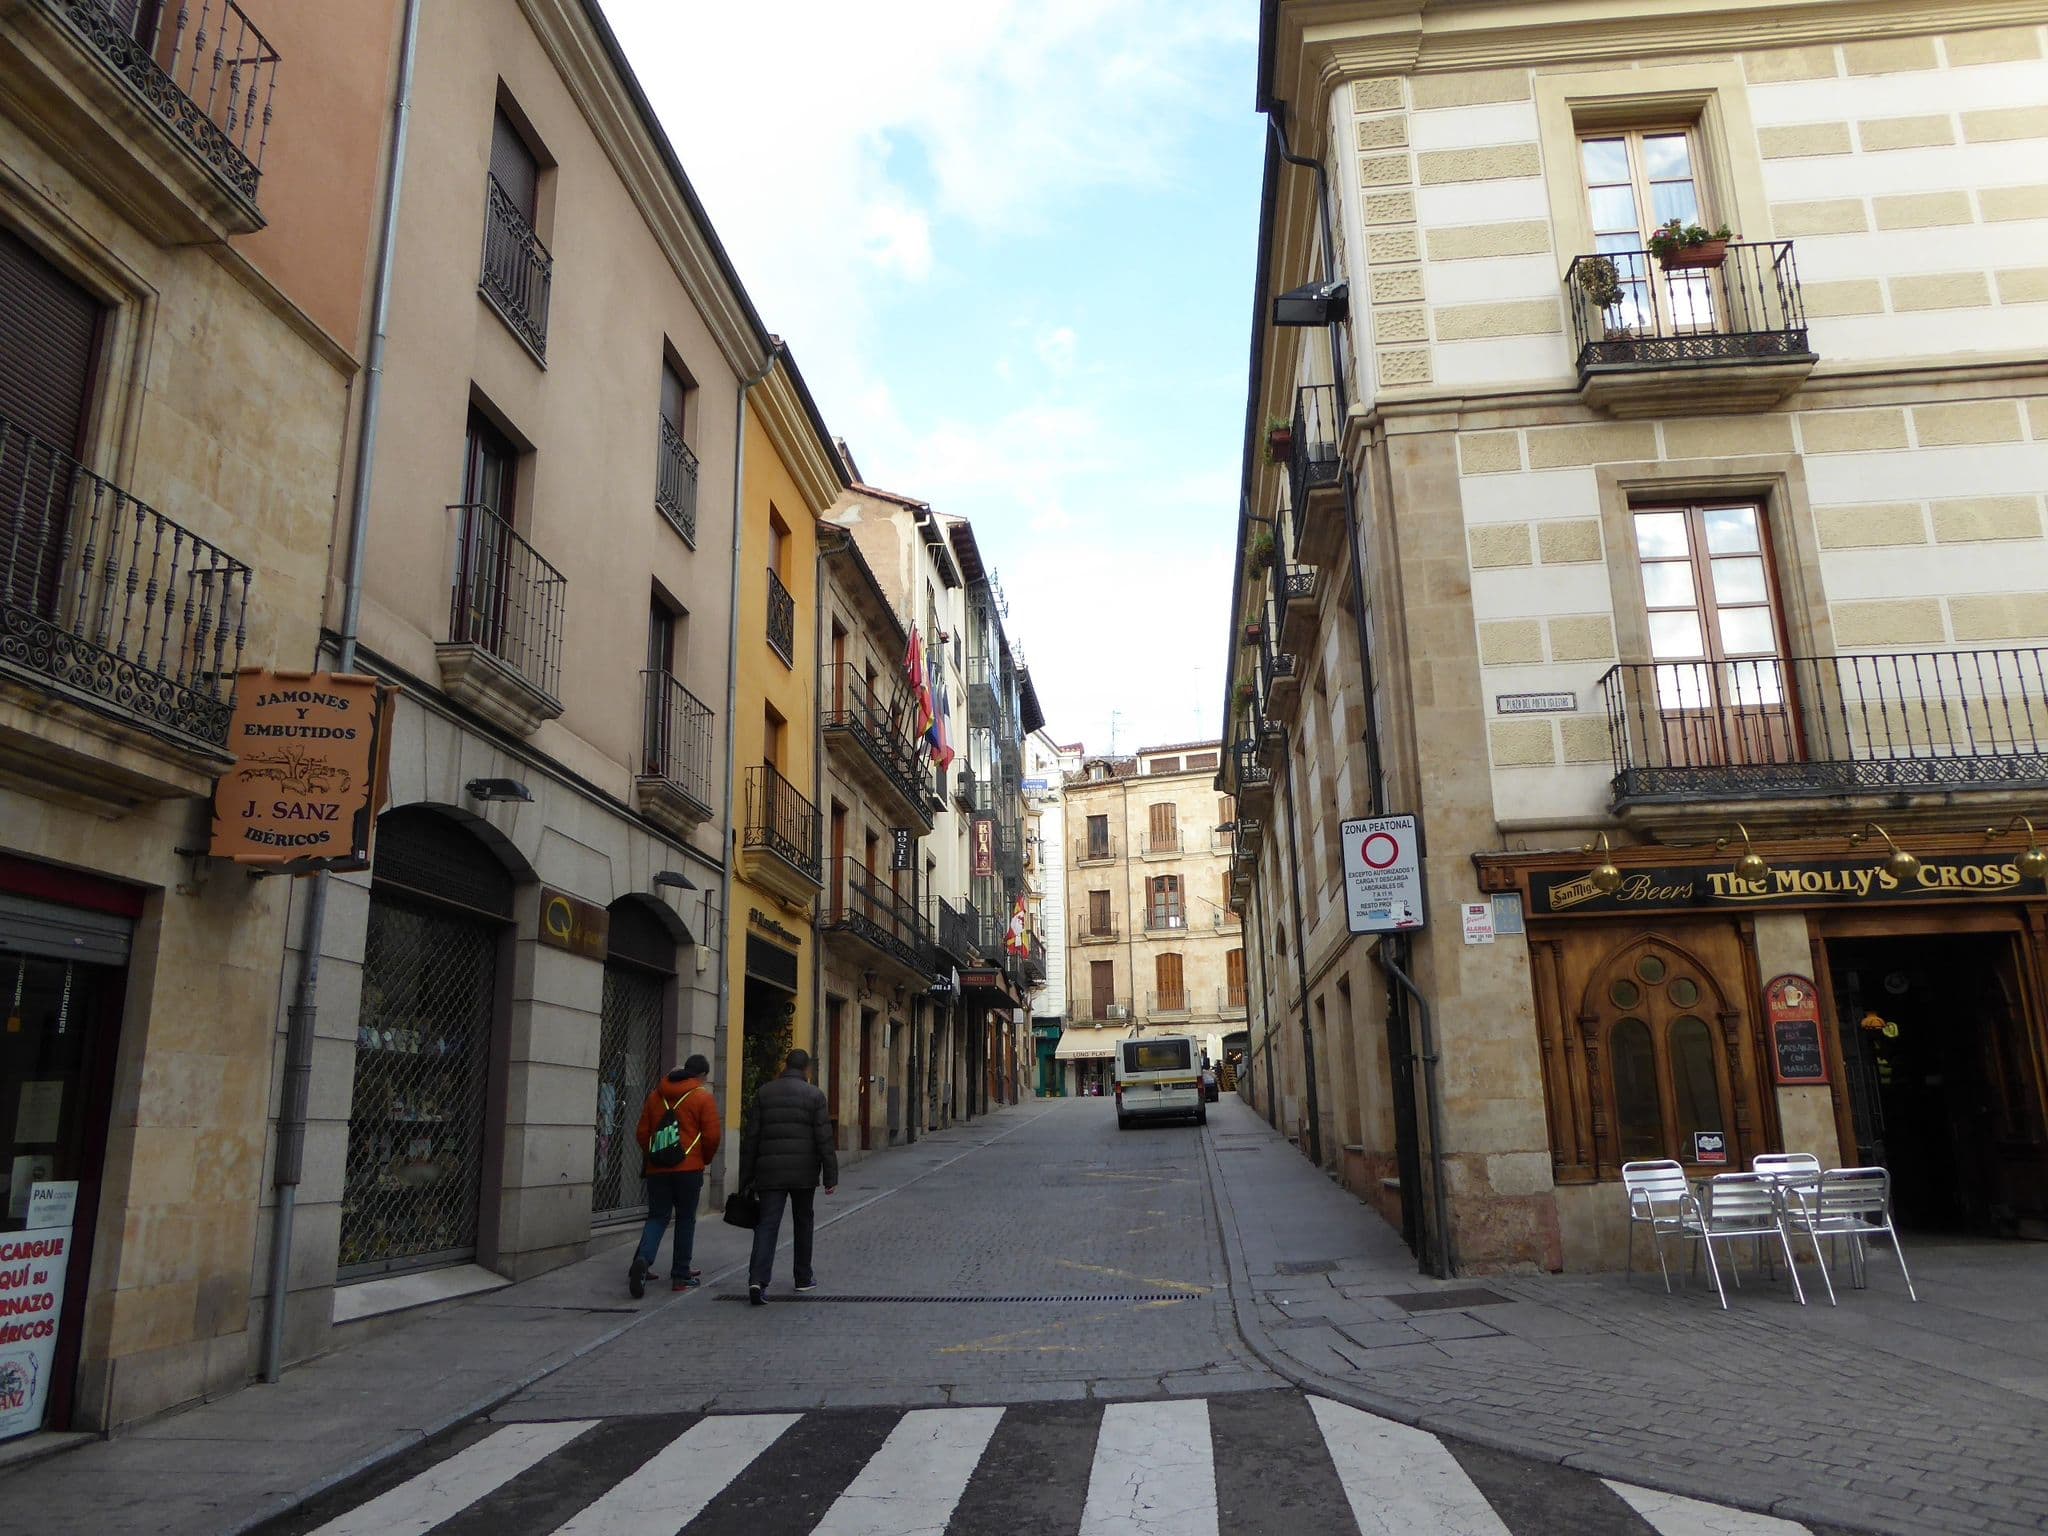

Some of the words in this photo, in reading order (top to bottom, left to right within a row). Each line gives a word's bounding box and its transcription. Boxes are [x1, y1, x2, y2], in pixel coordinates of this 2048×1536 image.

[256, 691, 349, 710] JAMONES
[296, 708, 309, 719] Y
[244, 724, 356, 740] EMBUTIDOS
[242, 801, 262, 818] J.
[272, 801, 340, 821] SANZ
[1345, 823, 1367, 835] ZONA
[1369, 819, 1413, 831] PEATONAL
[244, 827, 331, 847] IBÉRICOS
[1348, 870, 1373, 878] EXCEPTO
[1374, 867, 1410, 876] AUTORIZADOS
[1706, 869, 1767, 895] The
[1916, 864, 2022, 888] CROSS
[1361, 883, 1396, 891] LABORABLES
[1616, 874, 1694, 901] Beers
[33, 1188, 54, 1200] PAN
[0, 1238, 64, 1261] CARGUE
